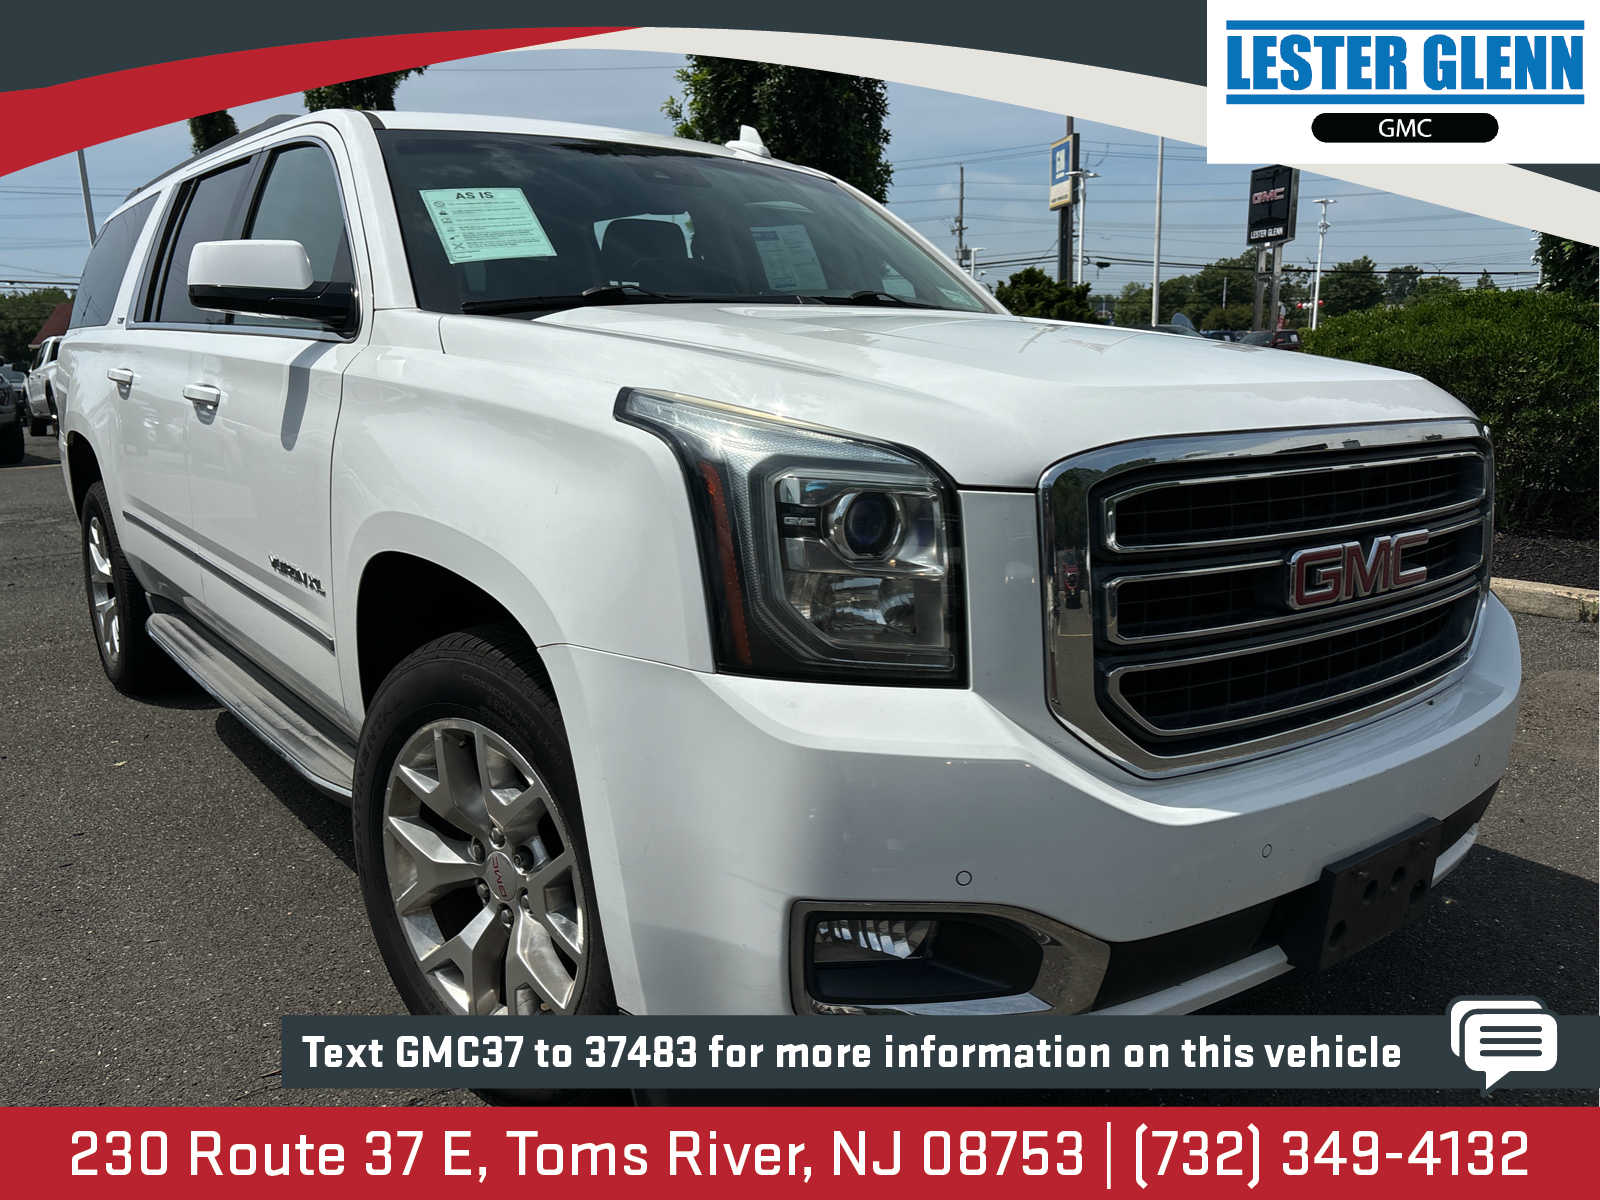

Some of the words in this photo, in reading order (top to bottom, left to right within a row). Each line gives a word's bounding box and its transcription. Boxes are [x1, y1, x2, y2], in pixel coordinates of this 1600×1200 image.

[455, 191, 475, 200] AS
[478, 191, 494, 199] IS
[1252, 187, 1285, 205] GMC
[1250, 229, 1267, 239] LESTER
[1267, 226, 1283, 237] GLENN
[783, 516, 817, 526] GMC
[1289, 528, 1430, 611] GMC
[492, 855, 508, 898] GMC
